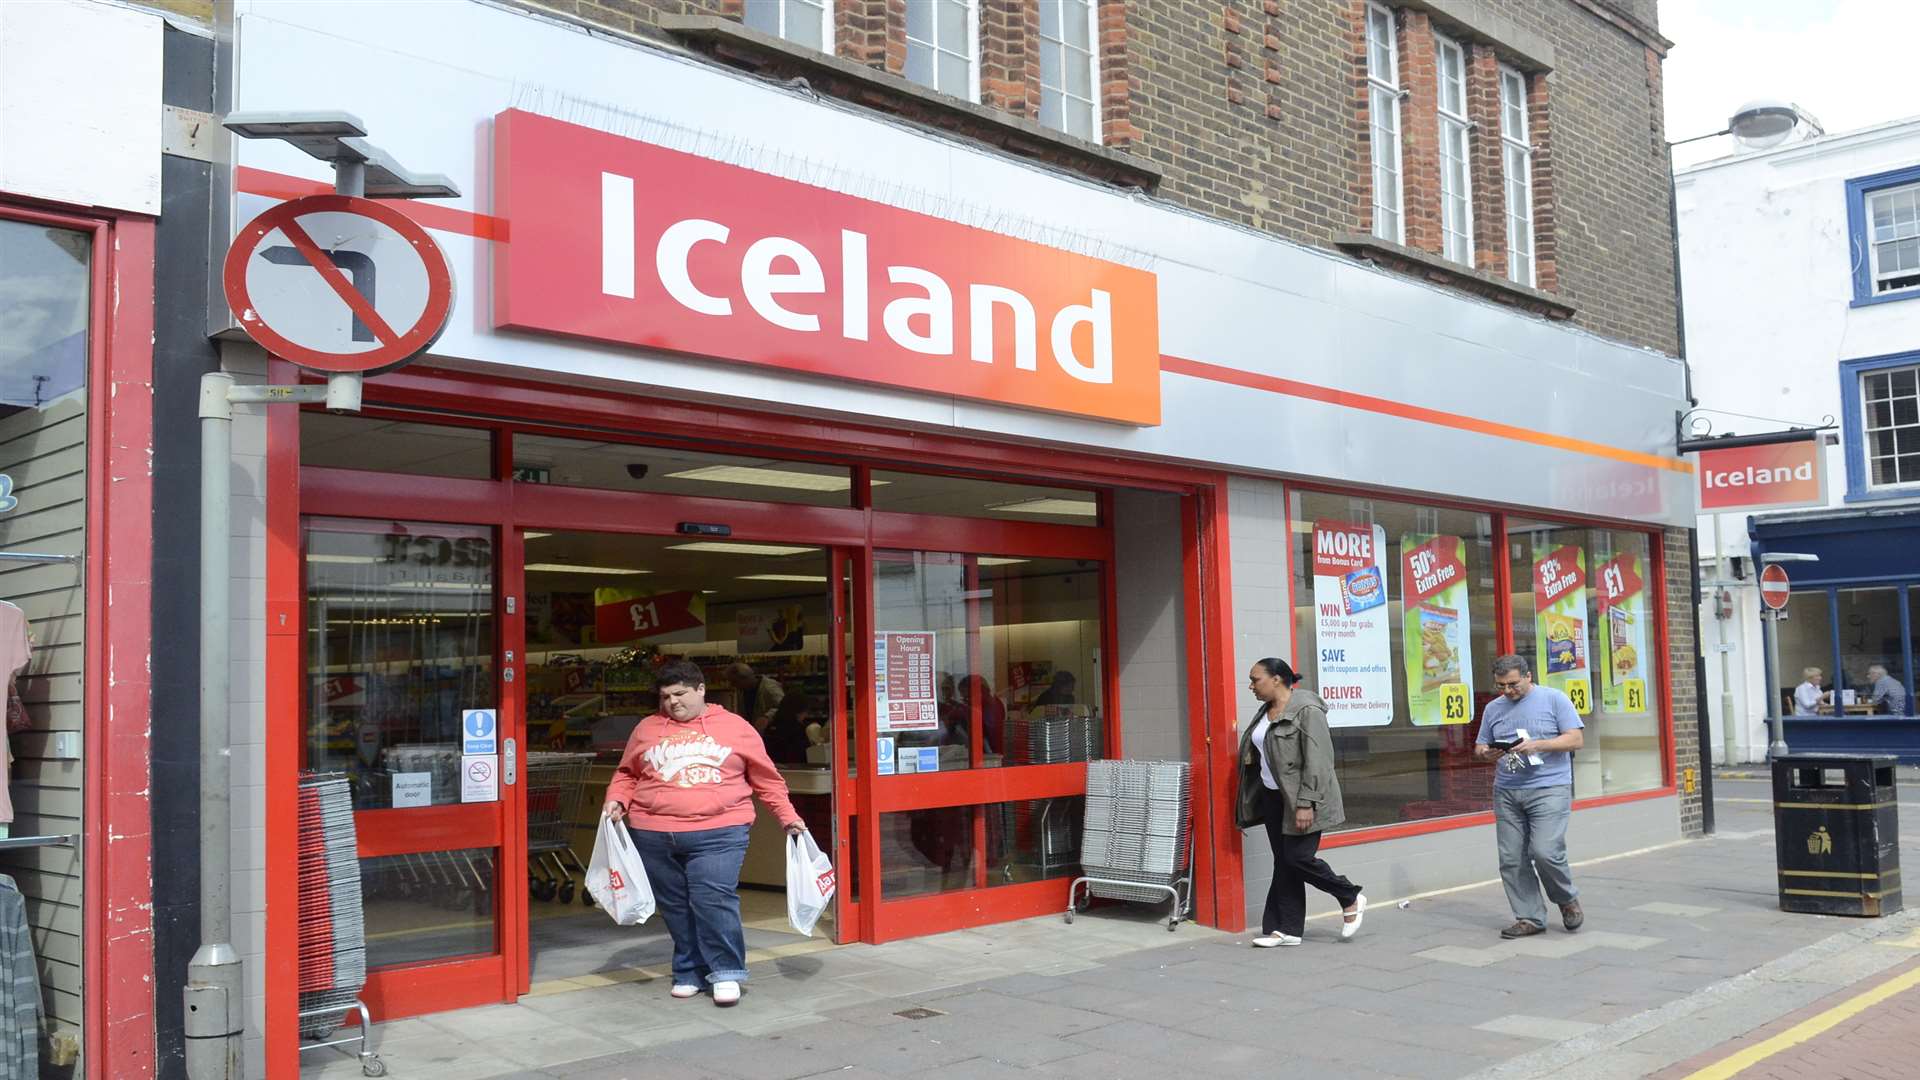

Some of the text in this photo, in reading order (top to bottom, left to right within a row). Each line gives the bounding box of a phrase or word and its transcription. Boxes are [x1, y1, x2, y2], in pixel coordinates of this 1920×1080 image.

[601, 171, 1113, 383] Iceland
[1705, 461, 1812, 488] Iceland
[1317, 530, 1371, 558] MORE
[1317, 556, 1363, 567] from Bonus Card
[1410, 549, 1436, 579] 50%
[1540, 559, 1562, 585] 33%
[1415, 564, 1455, 594] Extra Free
[1544, 572, 1577, 599] Extra Free
[1604, 564, 1624, 599] £1
[629, 601, 660, 631] £1
[1320, 603, 1341, 617] WIN
[1321, 631, 1336, 639] every
[1341, 621, 1348, 629] up
[1349, 620, 1357, 628] for
[896, 635, 925, 645] Opening
[900, 644, 920, 652] Hours
[1322, 649, 1345, 662] SAVE
[1336, 665, 1359, 674] coupons
[1372, 664, 1387, 672] offers
[1323, 686, 1362, 699] DELIVER
[1570, 688, 1584, 710] £3
[1629, 688, 1641, 708] £1
[1337, 702, 1348, 710] Free
[1350, 702, 1367, 710] Home
[1369, 702, 1390, 711] Delivery
[1446, 695, 1464, 719] £3
